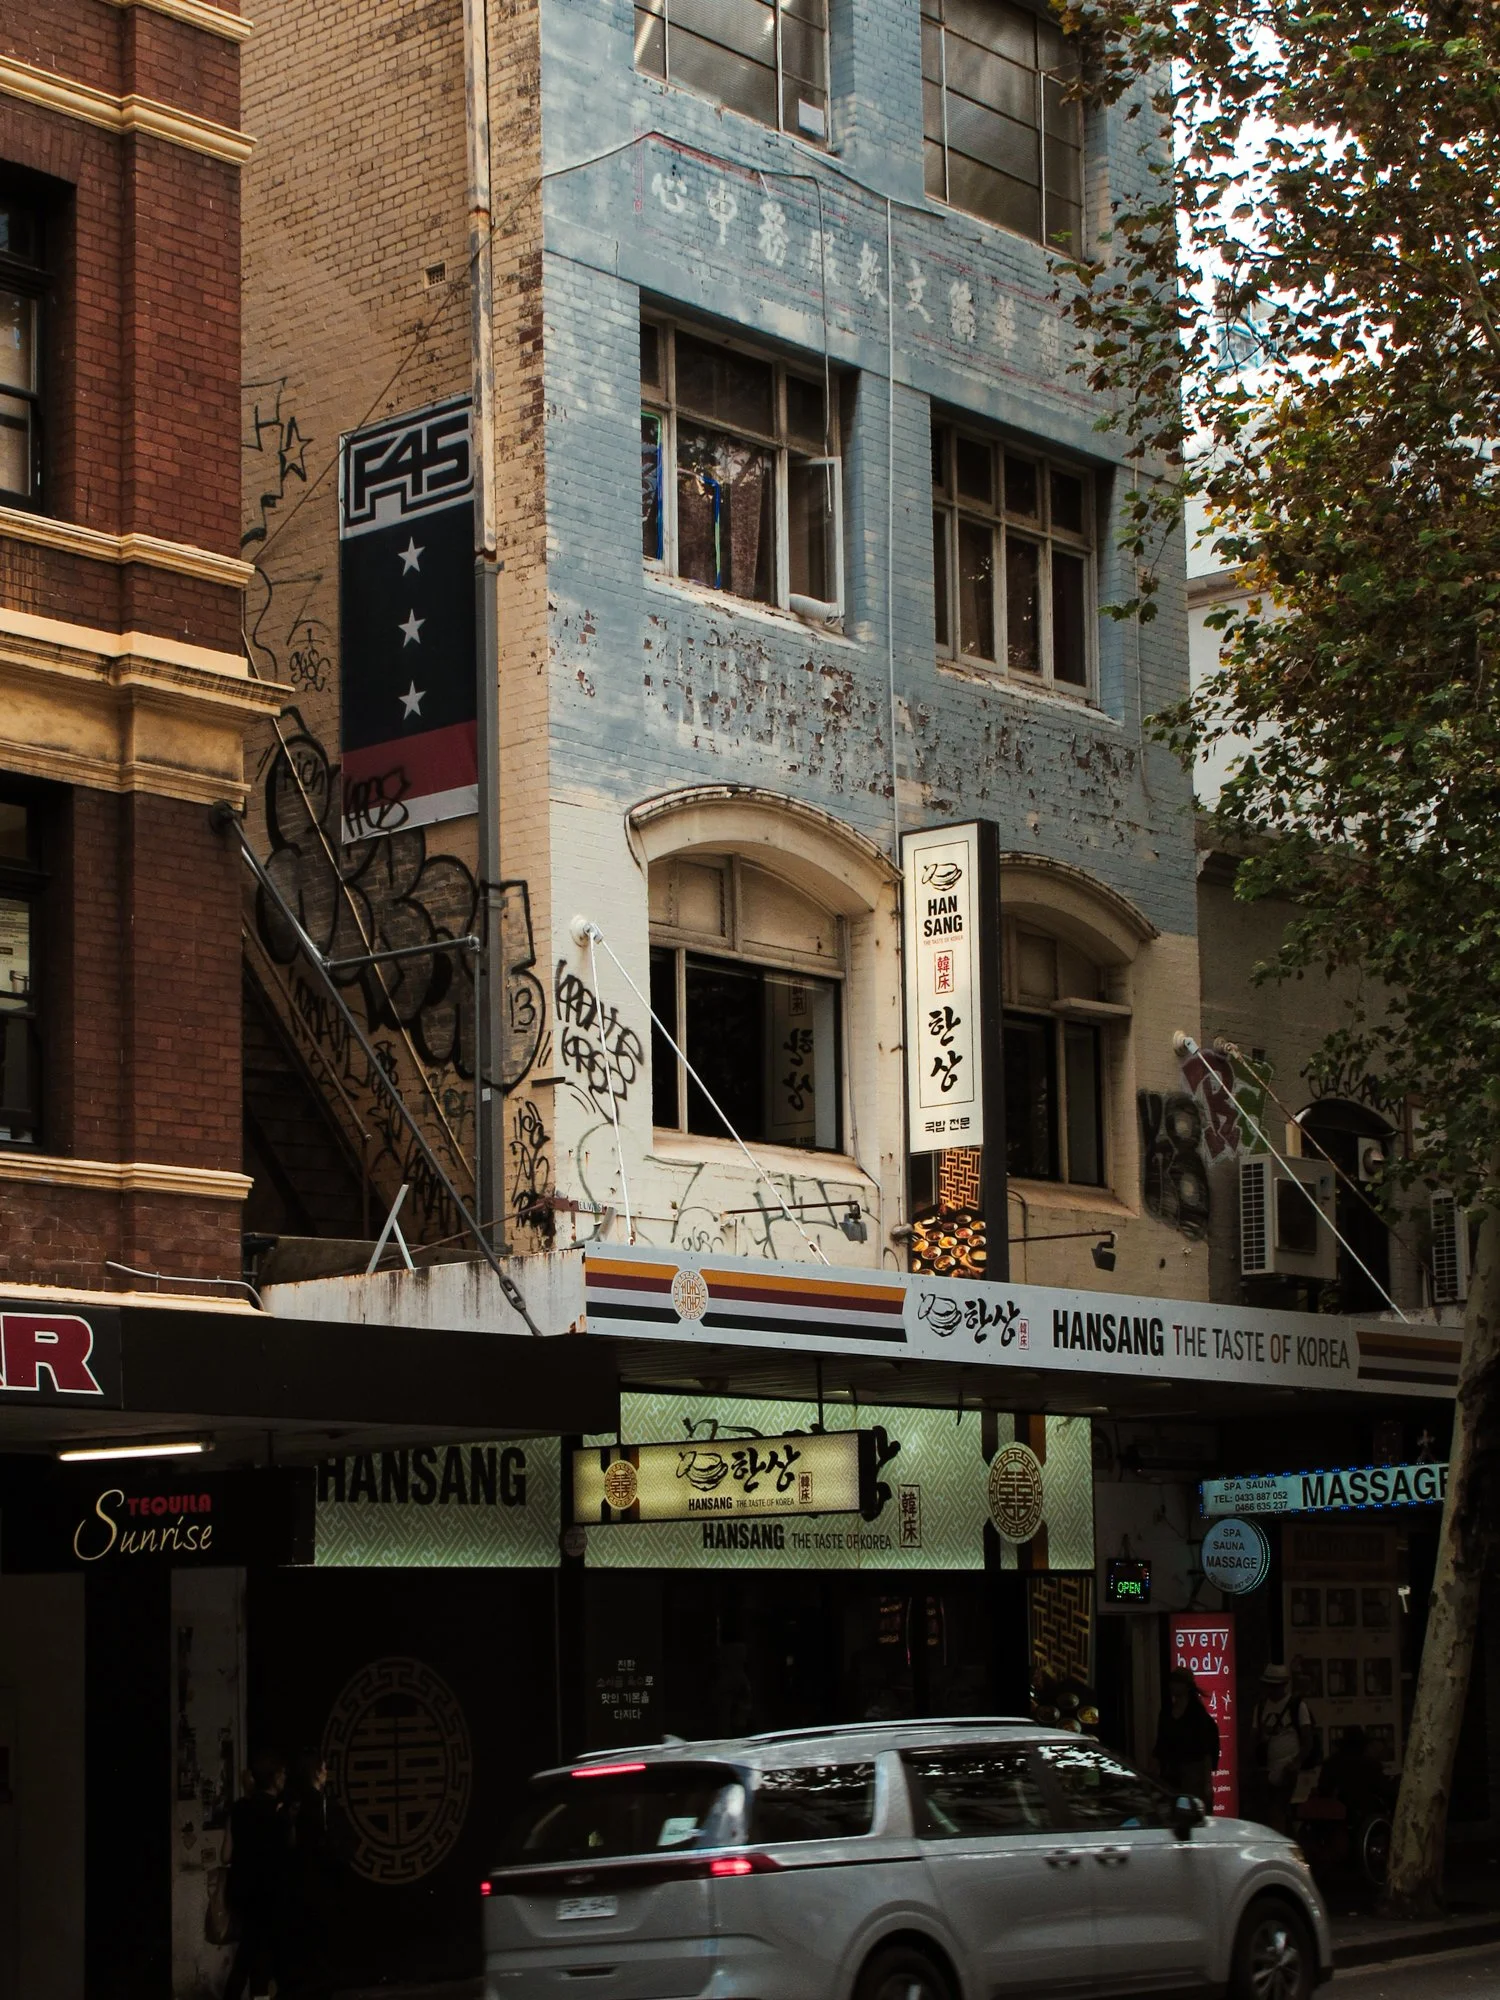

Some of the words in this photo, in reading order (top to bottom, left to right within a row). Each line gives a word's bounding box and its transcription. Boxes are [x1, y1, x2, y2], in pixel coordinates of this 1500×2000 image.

[349, 411, 475, 522] F45
[927, 895, 958, 916] HAN
[923, 915, 963, 937] SANG
[928, 1005, 964, 1093] 한상
[924, 1118, 947, 1134] 국밥
[948, 1116, 971, 1132] 전문
[963, 1297, 1021, 1347] 한상
[1052, 1309, 1164, 1357] HANSANG
[1172, 1323, 1207, 1359] THE
[1212, 1327, 1265, 1363] TASTE
[1270, 1333, 1292, 1364] OF
[1298, 1334, 1350, 1370] KOREA
[317, 1446, 527, 1507] HANSANG
[731, 1444, 802, 1493] 한상
[1223, 1482, 1242, 1491] SPA
[1245, 1479, 1277, 1491] SAUNA
[127, 1493, 212, 1517] TEQUILA
[688, 1496, 733, 1512] HANSANG
[736, 1499, 748, 1509] THE
[749, 1498, 765, 1508] TASTE
[766, 1498, 775, 1507] OF
[775, 1497, 795, 1507] KOREA
[1214, 1495, 1233, 1504] TEL:
[1235, 1492, 1255, 1503] 0433
[1273, 1490, 1288, 1500] 052
[1273, 1500, 1288, 1511] 237
[73, 1489, 213, 1561] Sunrise
[901, 1491, 919, 1543] 韓床
[702, 1522, 785, 1551] HANSANG
[791, 1531, 811, 1550] THE
[813, 1532, 844, 1550] TASTE
[846, 1533, 859, 1550] OF
[860, 1534, 892, 1551] KOREA
[1223, 1528, 1241, 1538] SPA
[1213, 1541, 1245, 1552] SAUNA
[1206, 1555, 1258, 1570] MASSAGE
[1117, 1581, 1141, 1595] OPEN
[1176, 1632, 1229, 1651] every
[613, 1708, 642, 1720] 다지다
